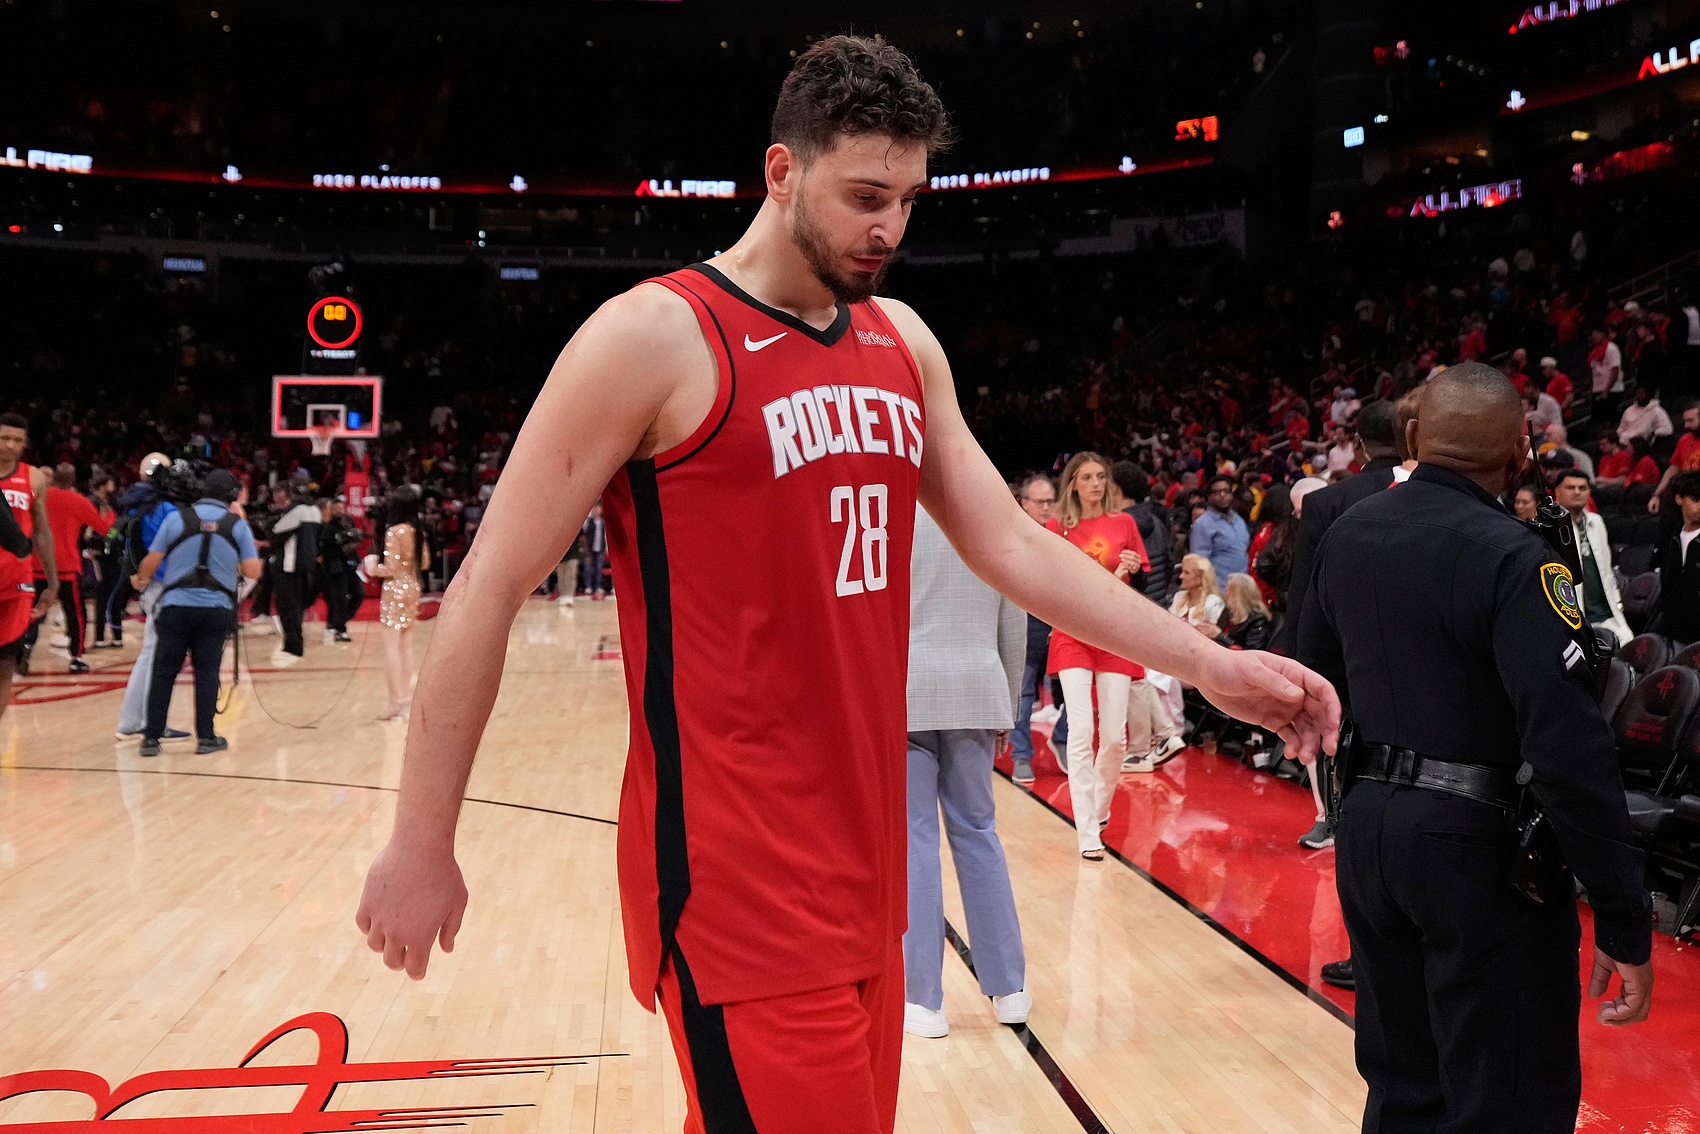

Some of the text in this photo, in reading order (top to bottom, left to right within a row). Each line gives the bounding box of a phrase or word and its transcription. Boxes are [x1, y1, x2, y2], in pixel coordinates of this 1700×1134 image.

[1637, 46, 1688, 80] ALL
[27, 149, 93, 174] FIRE
[360, 175, 441, 190] PLAYOFFS
[634, 179, 736, 198] ALL FIRE
[973, 167, 1049, 186] PLAYOFFS
[1410, 191, 1458, 217] ALL
[761, 384, 923, 480] ROCKETS
[831, 484, 888, 597] 28
